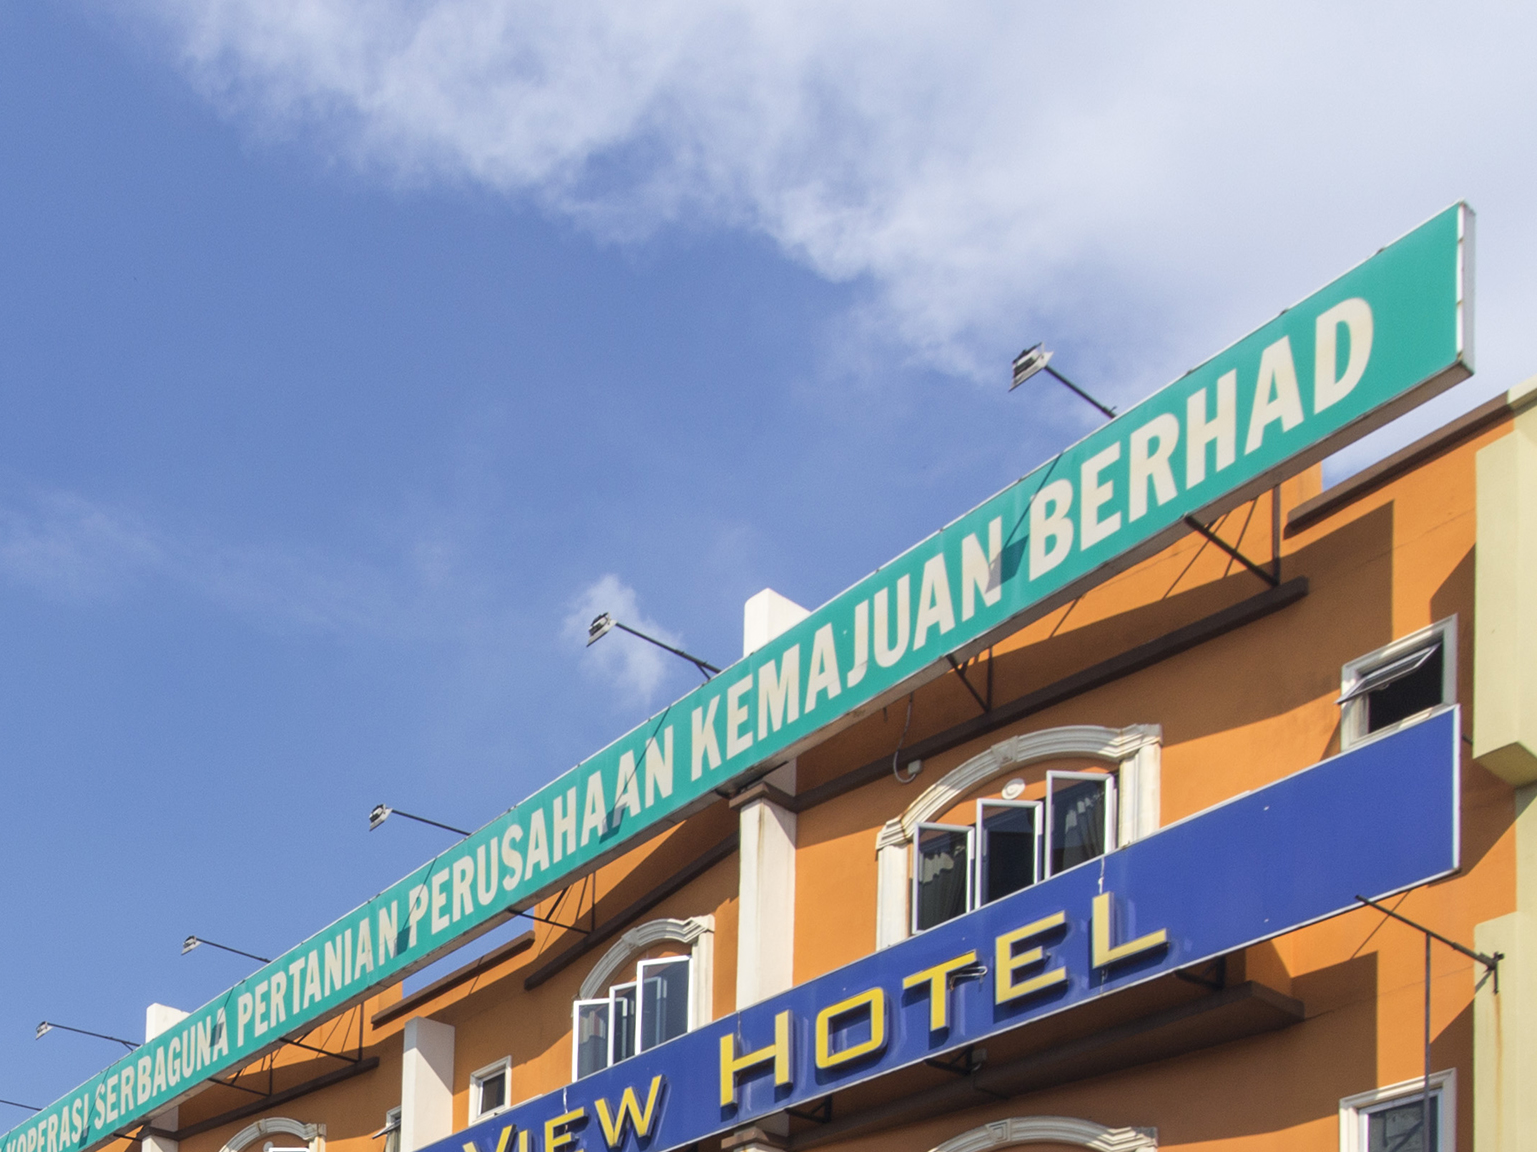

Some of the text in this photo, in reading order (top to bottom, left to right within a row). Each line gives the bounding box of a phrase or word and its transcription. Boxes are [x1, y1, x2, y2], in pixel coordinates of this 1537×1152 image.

[94, 1007, 229, 1130] SERBAGUNA
[237, 900, 398, 1047] PERTANIAN
[408, 725, 674, 948] PERUSAHAAN
[691, 517, 1003, 782] KEMAJUAN
[1028, 296, 1375, 582] BERHAD
[719, 891, 1169, 1108] HOTEL
